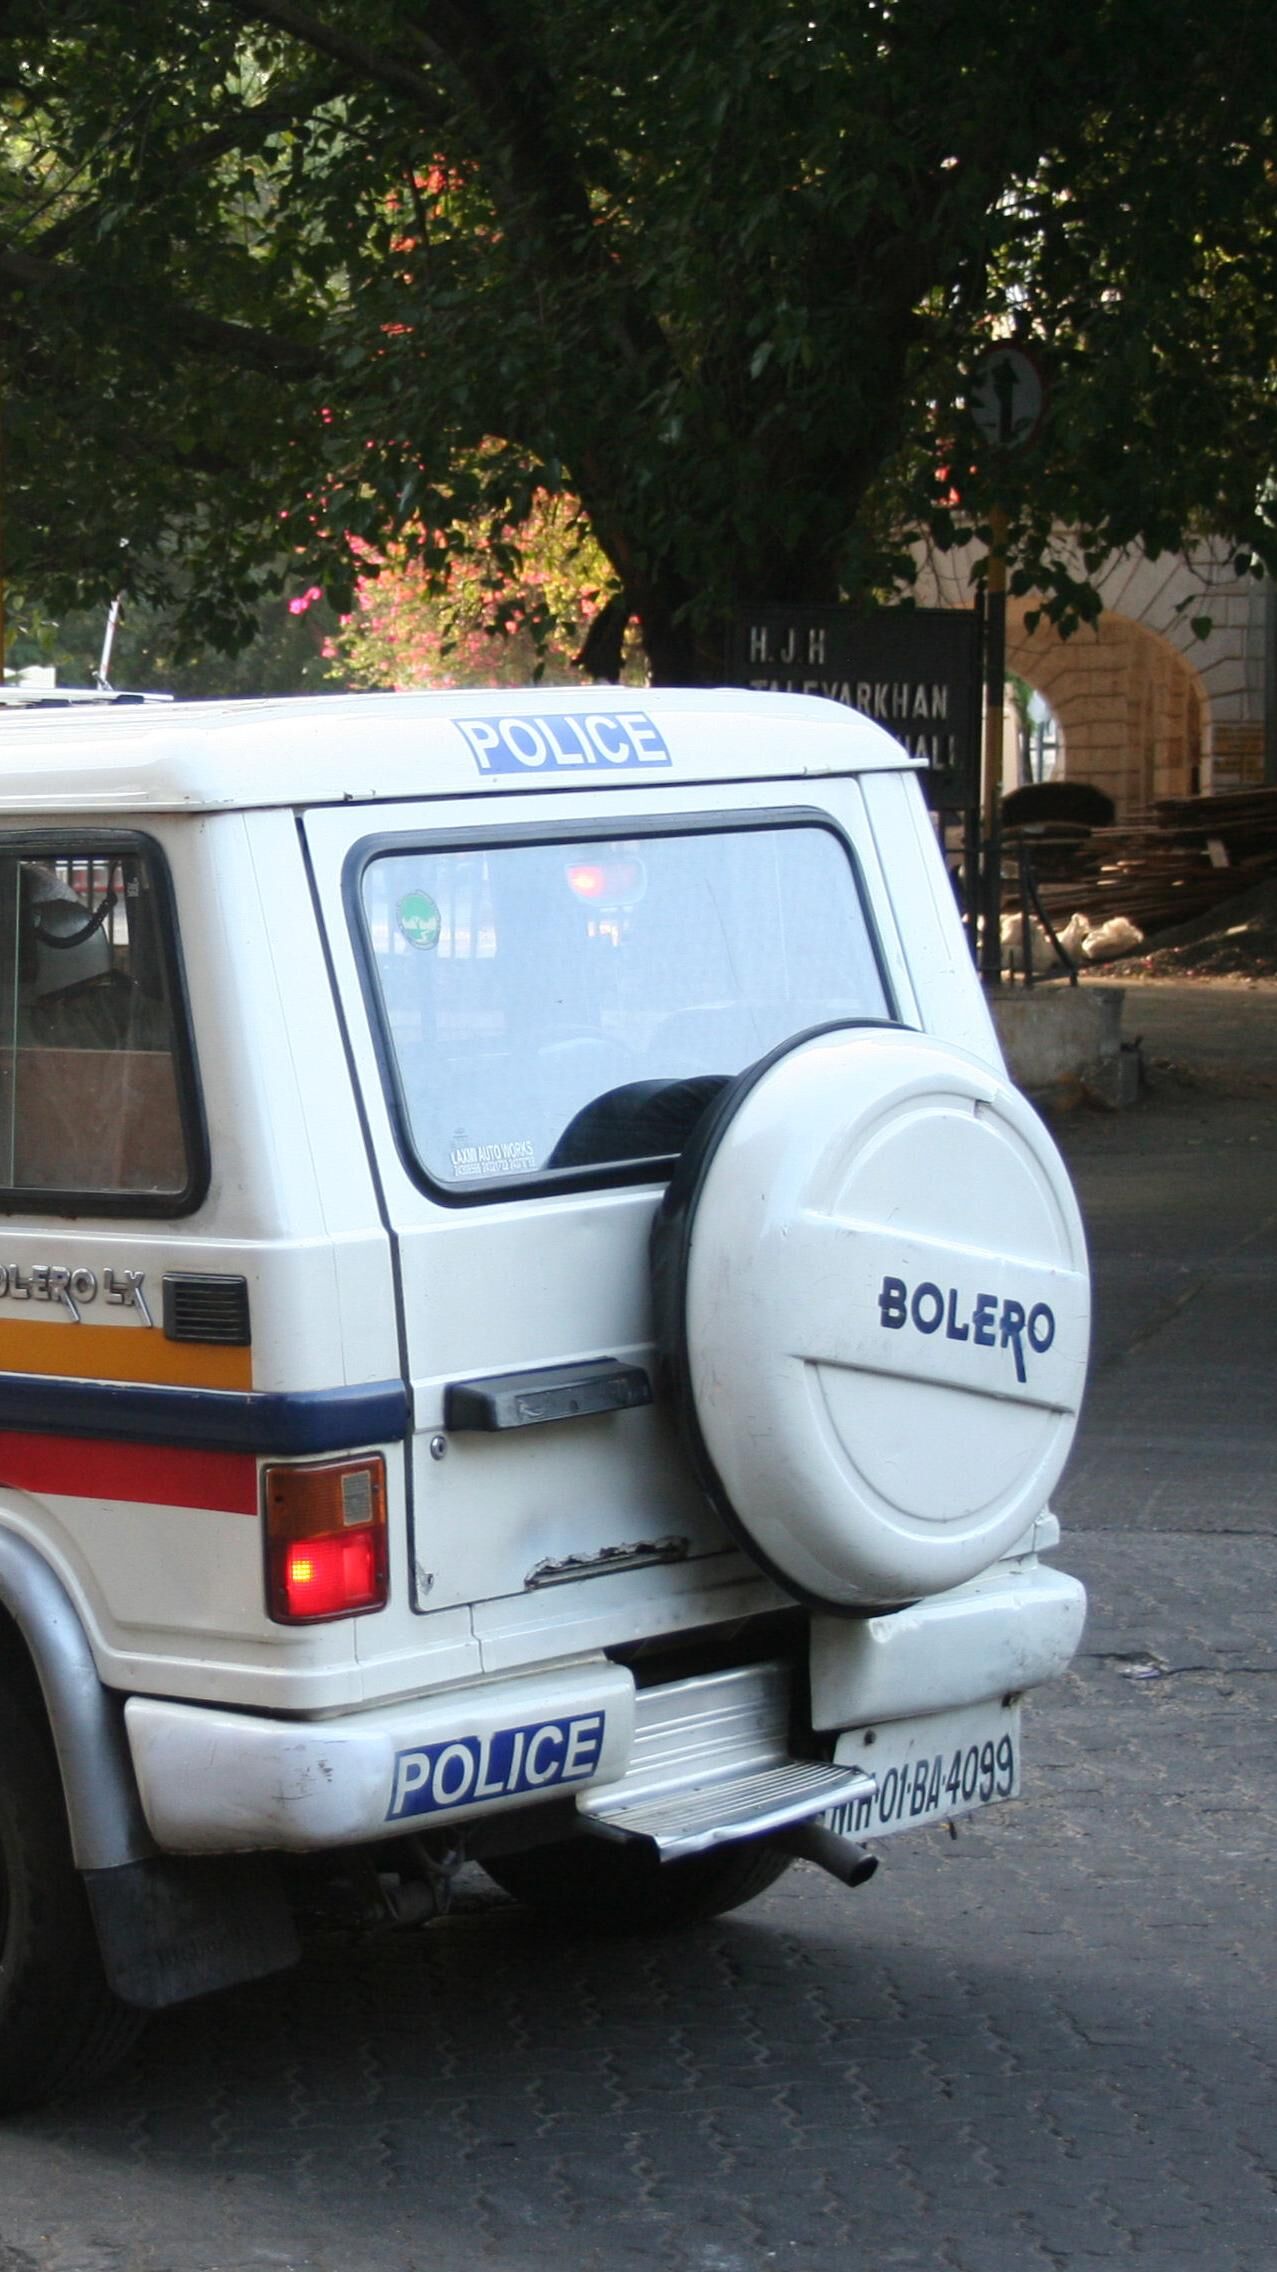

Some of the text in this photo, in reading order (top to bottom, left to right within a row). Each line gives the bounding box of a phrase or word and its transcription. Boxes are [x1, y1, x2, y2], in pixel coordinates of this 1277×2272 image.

[456, 714, 668, 769] POLICE
[478, 1144, 502, 1161] AUTO
[501, 1140, 534, 1159] WORKS
[878, 1275, 1056, 1384] BOLERO
[391, 1716, 601, 1814] POLICE
